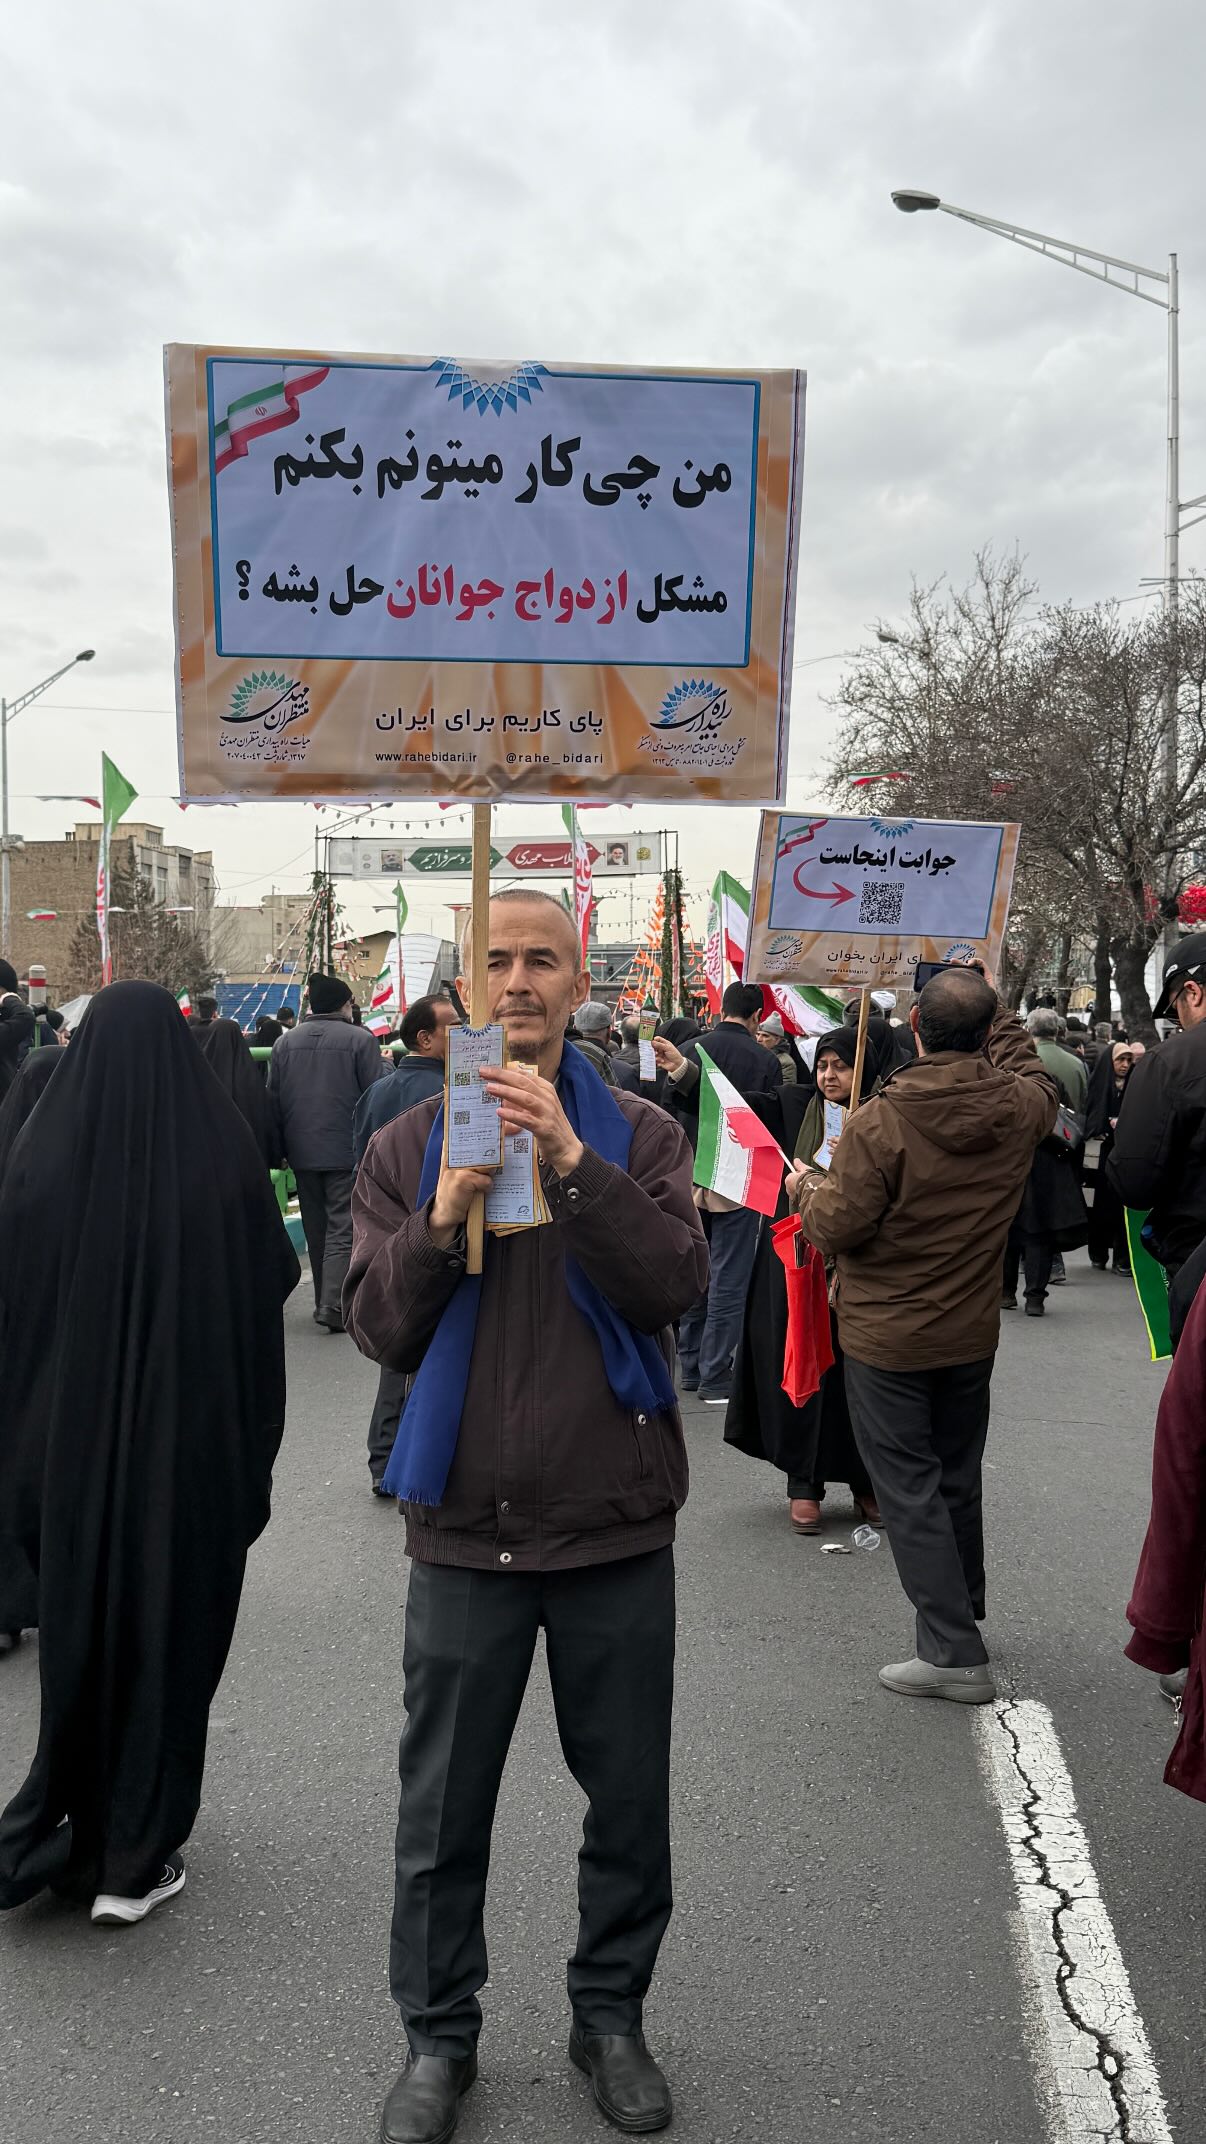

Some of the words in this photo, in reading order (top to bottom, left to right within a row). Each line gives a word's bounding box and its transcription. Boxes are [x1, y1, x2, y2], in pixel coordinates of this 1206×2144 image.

[274, 427, 363, 496] بکنم
[377, 428, 503, 500] میتونم
[515, 433, 581, 503] کار
[583, 454, 661, 510] چی
[673, 459, 732, 508] من
[262, 563, 319, 615] بشه
[329, 564, 385, 616] حل
[386, 562, 504, 621] جوانان
[515, 567, 627, 624] ازدواج
[636, 573, 728, 623] مشکل
[375, 707, 435, 731] ایران
[445, 708, 495, 732] برای
[503, 709, 561, 733] کاریم
[569, 710, 603, 736] پای
[375, 752, 478, 762] www.rahebidari.ir
[819, 843, 896, 874] اینجاست
[898, 847, 957, 877] جوابت
[827, 949, 866, 963] بخوان
[870, 951, 902, 964] ایران
